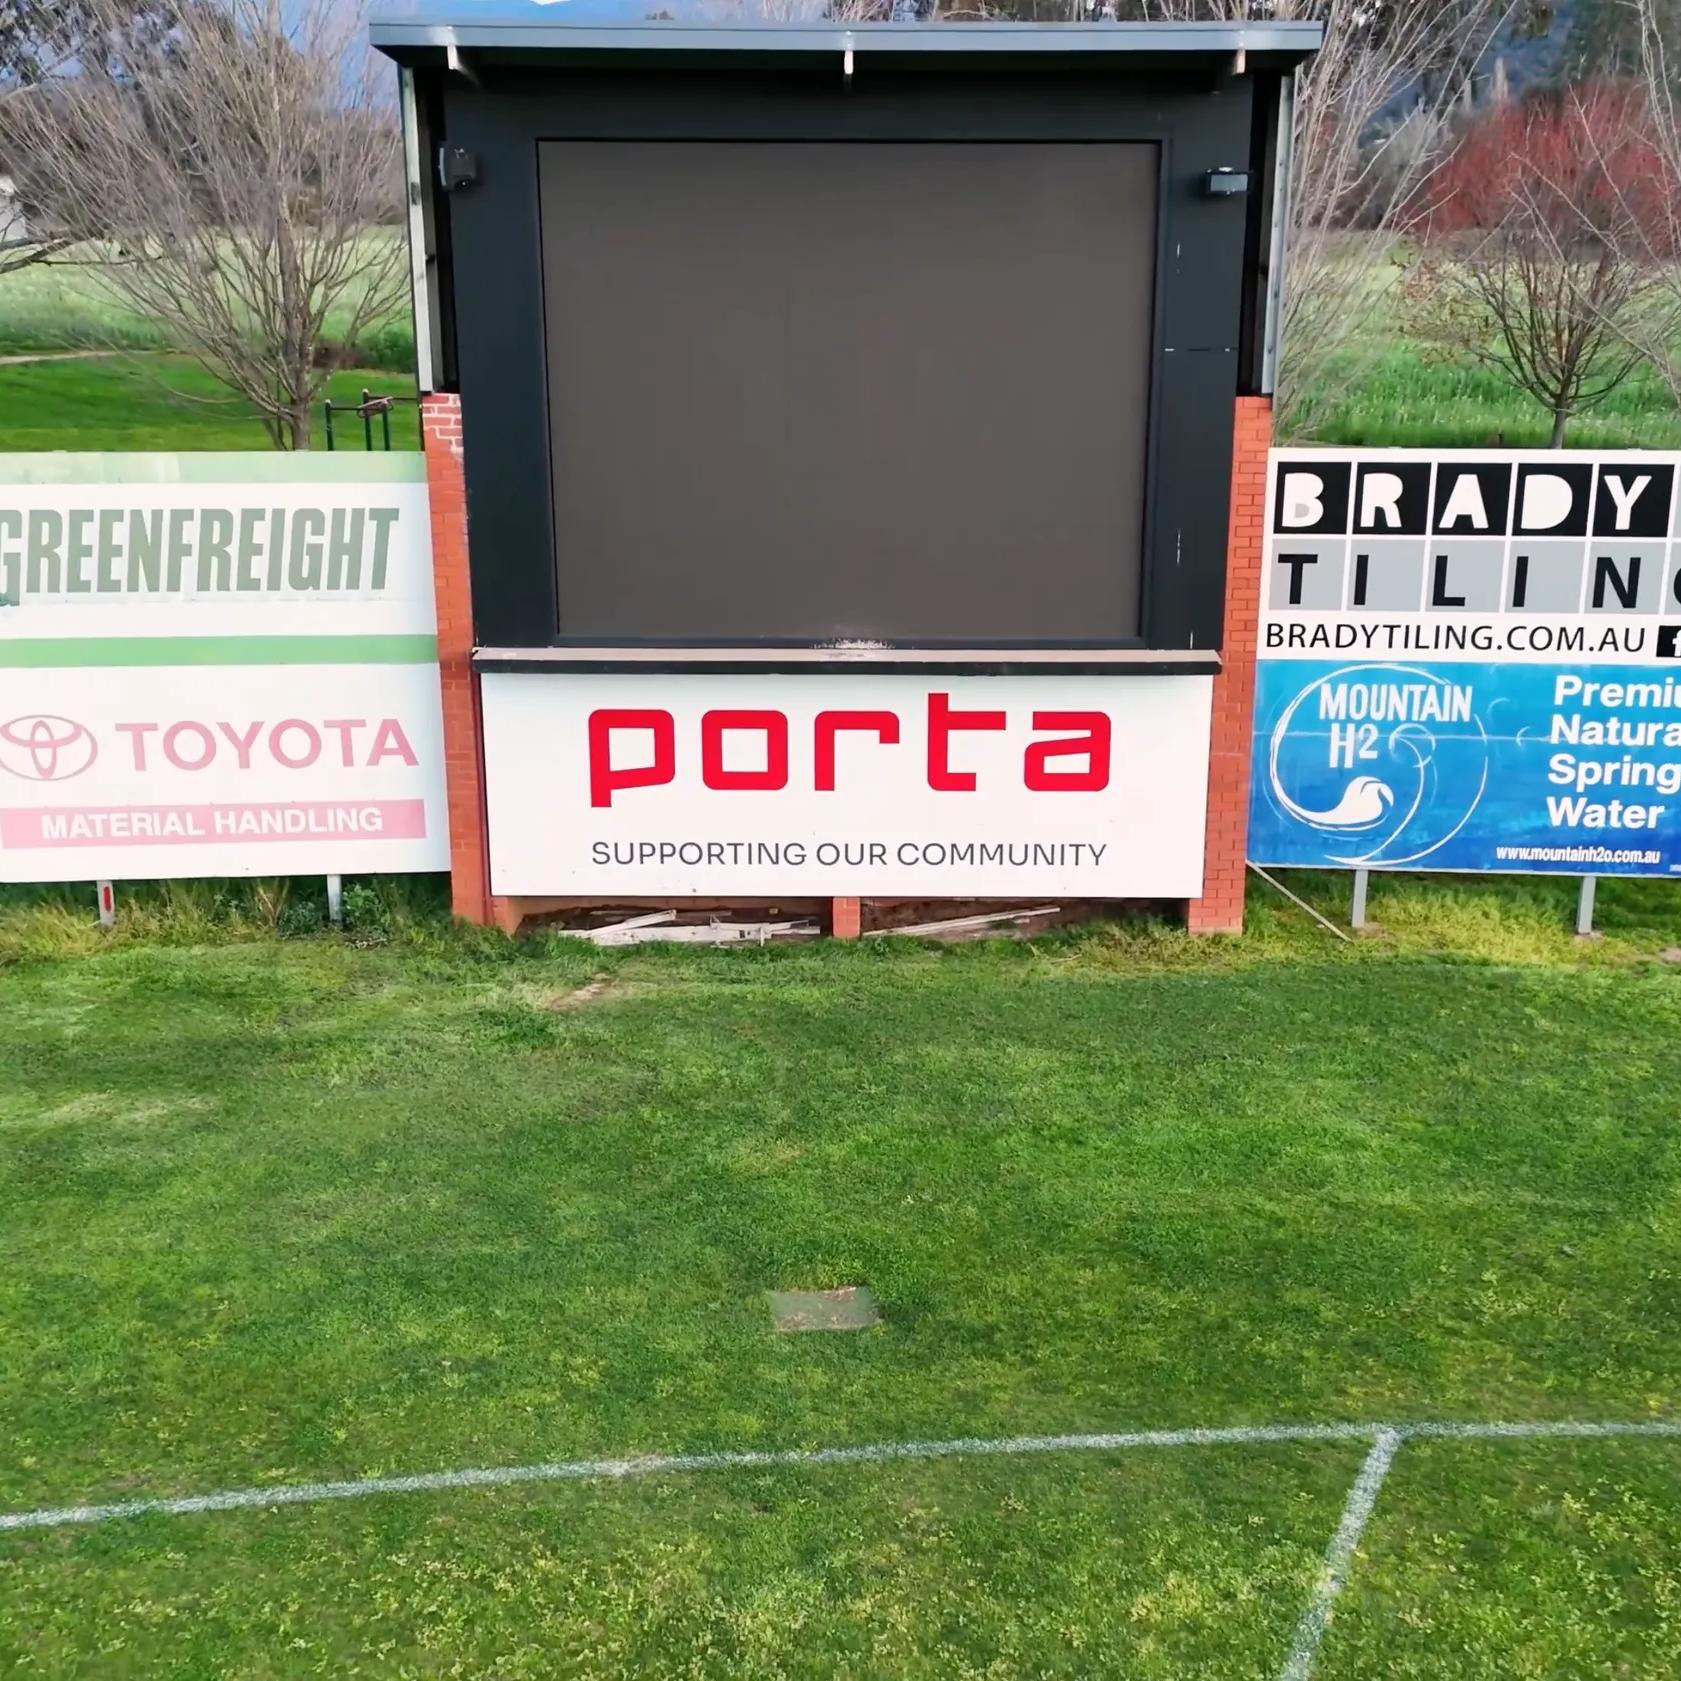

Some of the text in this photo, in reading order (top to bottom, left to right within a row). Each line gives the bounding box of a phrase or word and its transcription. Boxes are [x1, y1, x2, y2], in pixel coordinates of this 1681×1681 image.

[1280, 471, 1651, 531] BRADY
[0, 508, 399, 606] GREENFREIGHT
[1277, 554, 1681, 609] TILIN
[1267, 623, 1646, 652] BRADYTILING.COM.AU
[1319, 683, 1473, 723] MOUNTAIN
[115, 718, 420, 773] TOYOTA
[588, 692, 1112, 808] porta
[1548, 755, 1681, 793] Spring
[41, 800, 384, 840] MATERIAL HANDLING
[1547, 796, 1665, 829] Water
[592, 841, 1108, 867] SUPPORTING OUR COMMUNITY
[1496, 846, 1661, 864] www.mountainh2o.com.au
